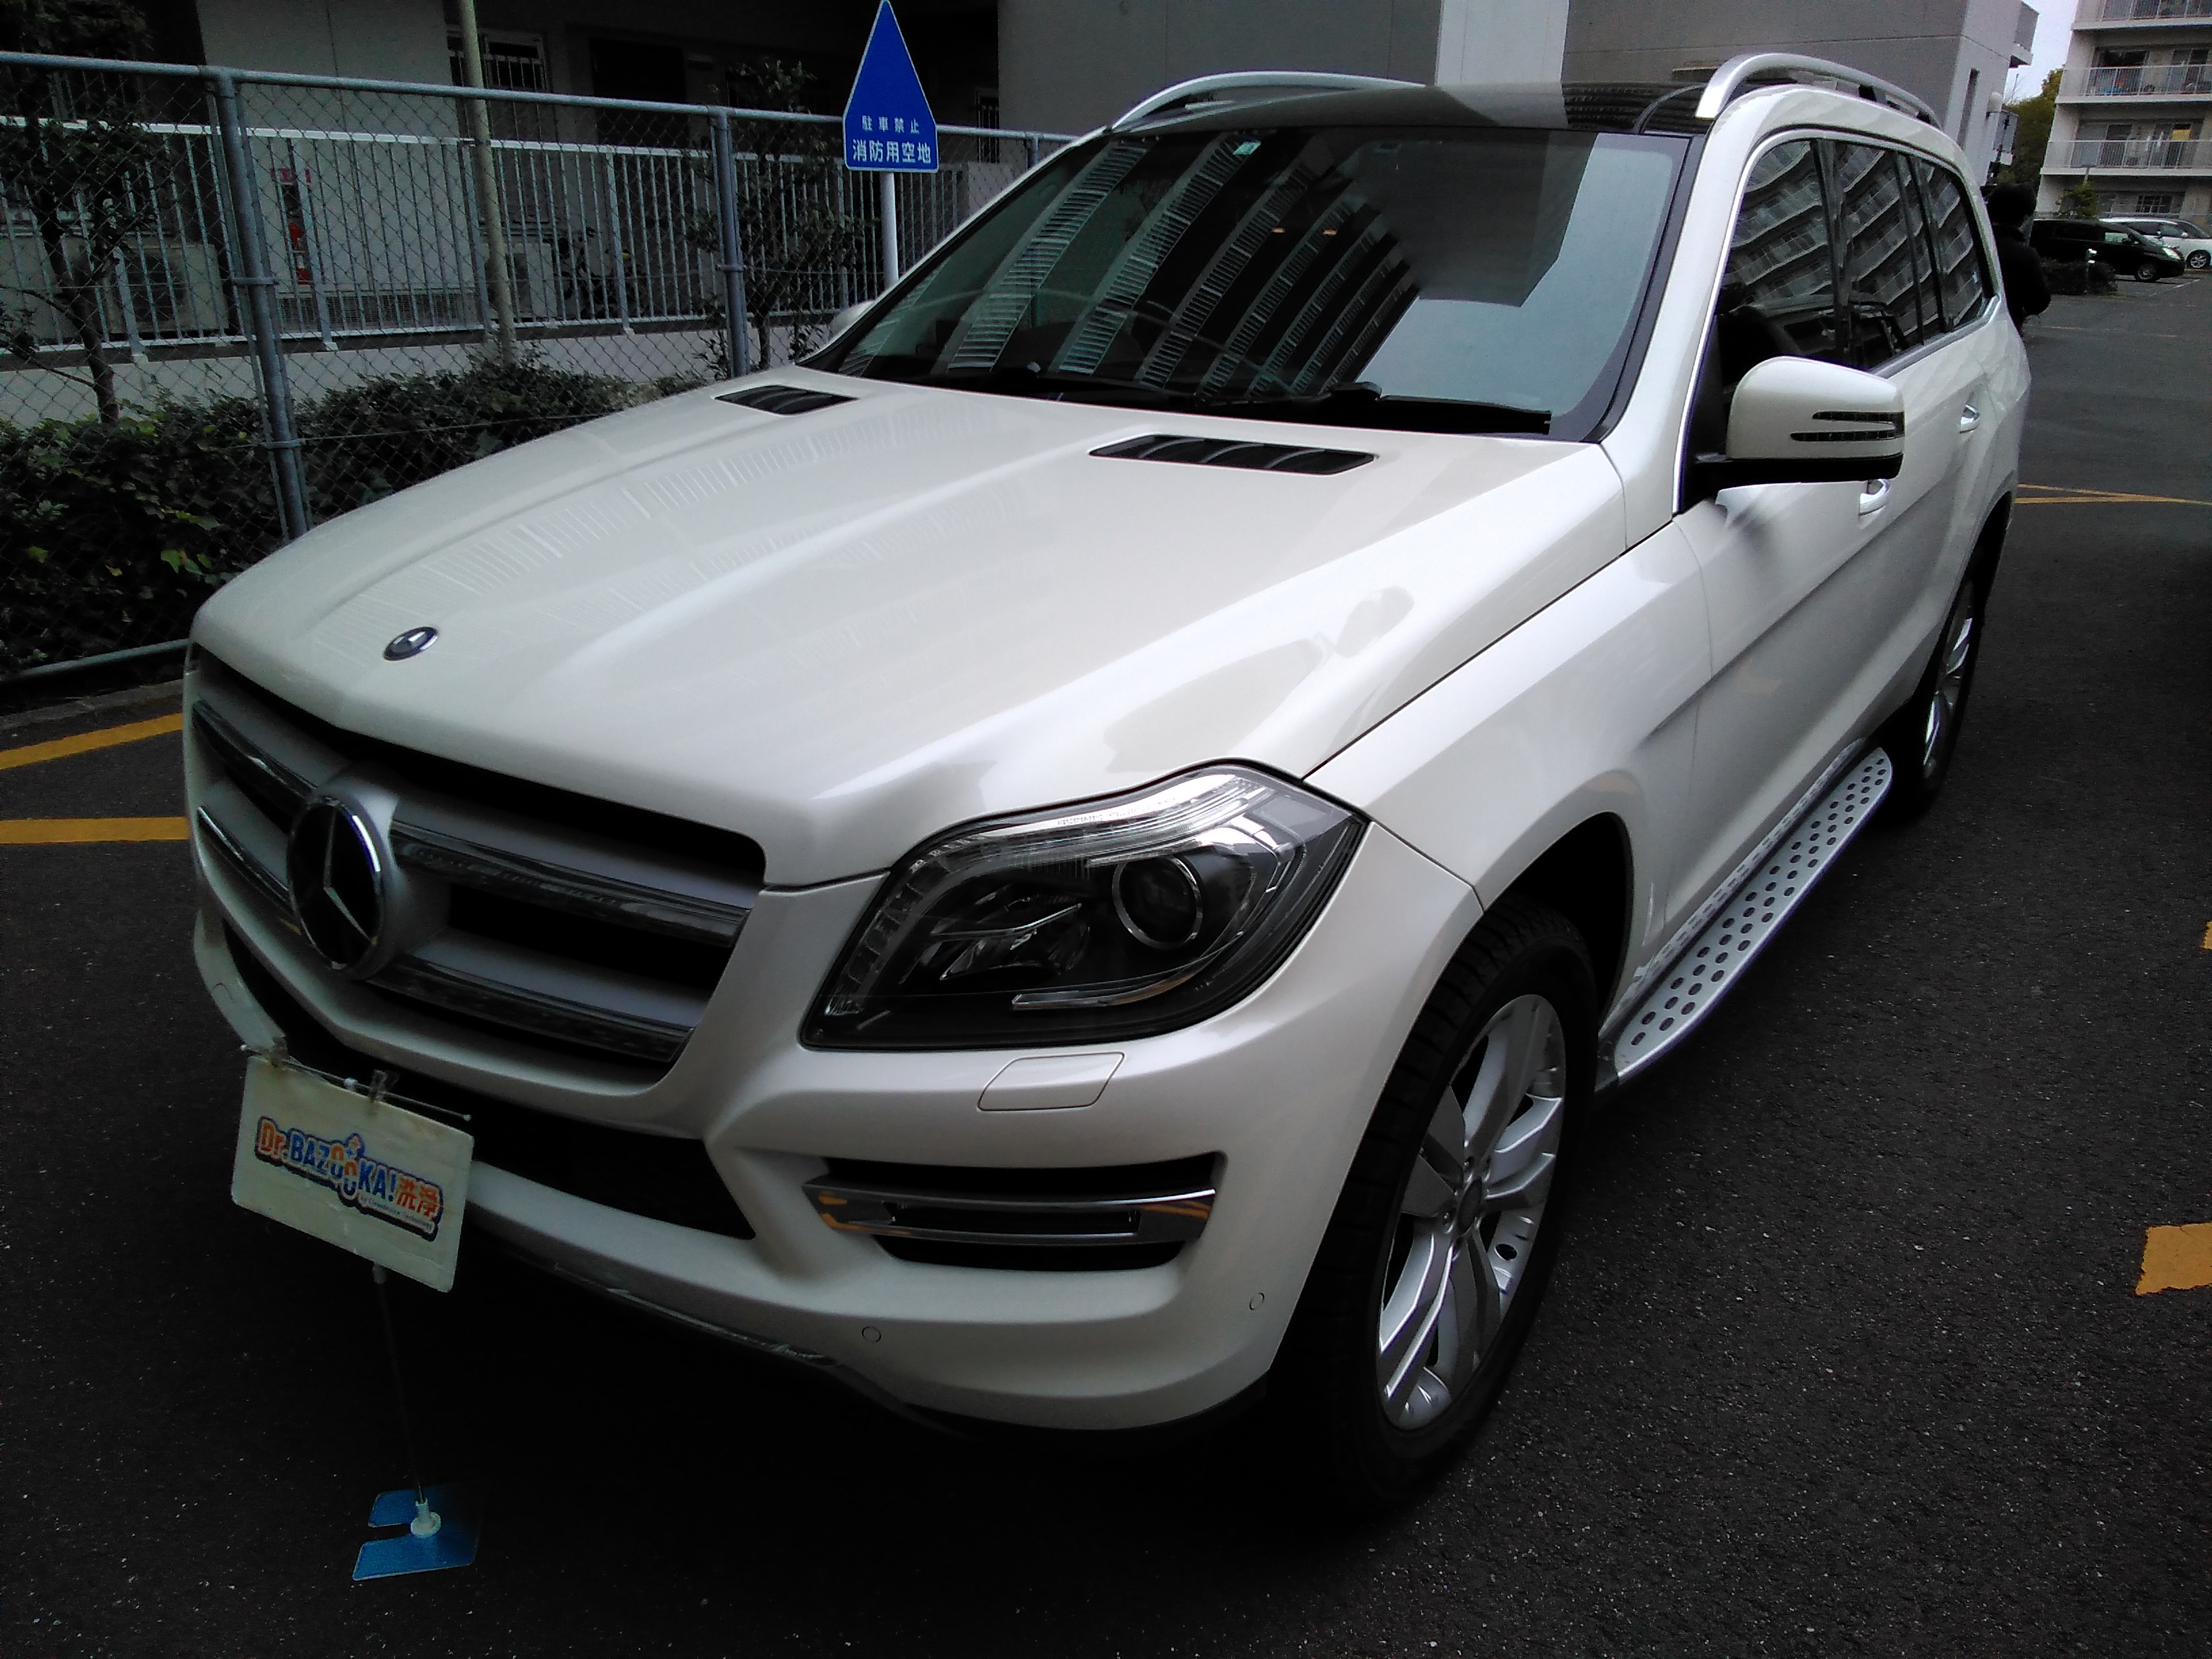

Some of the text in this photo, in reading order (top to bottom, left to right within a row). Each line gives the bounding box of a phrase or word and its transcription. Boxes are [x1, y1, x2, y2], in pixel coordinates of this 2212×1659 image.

[861, 115, 920, 134] 駐車禁止
[853, 138, 931, 164] 消防用空地
